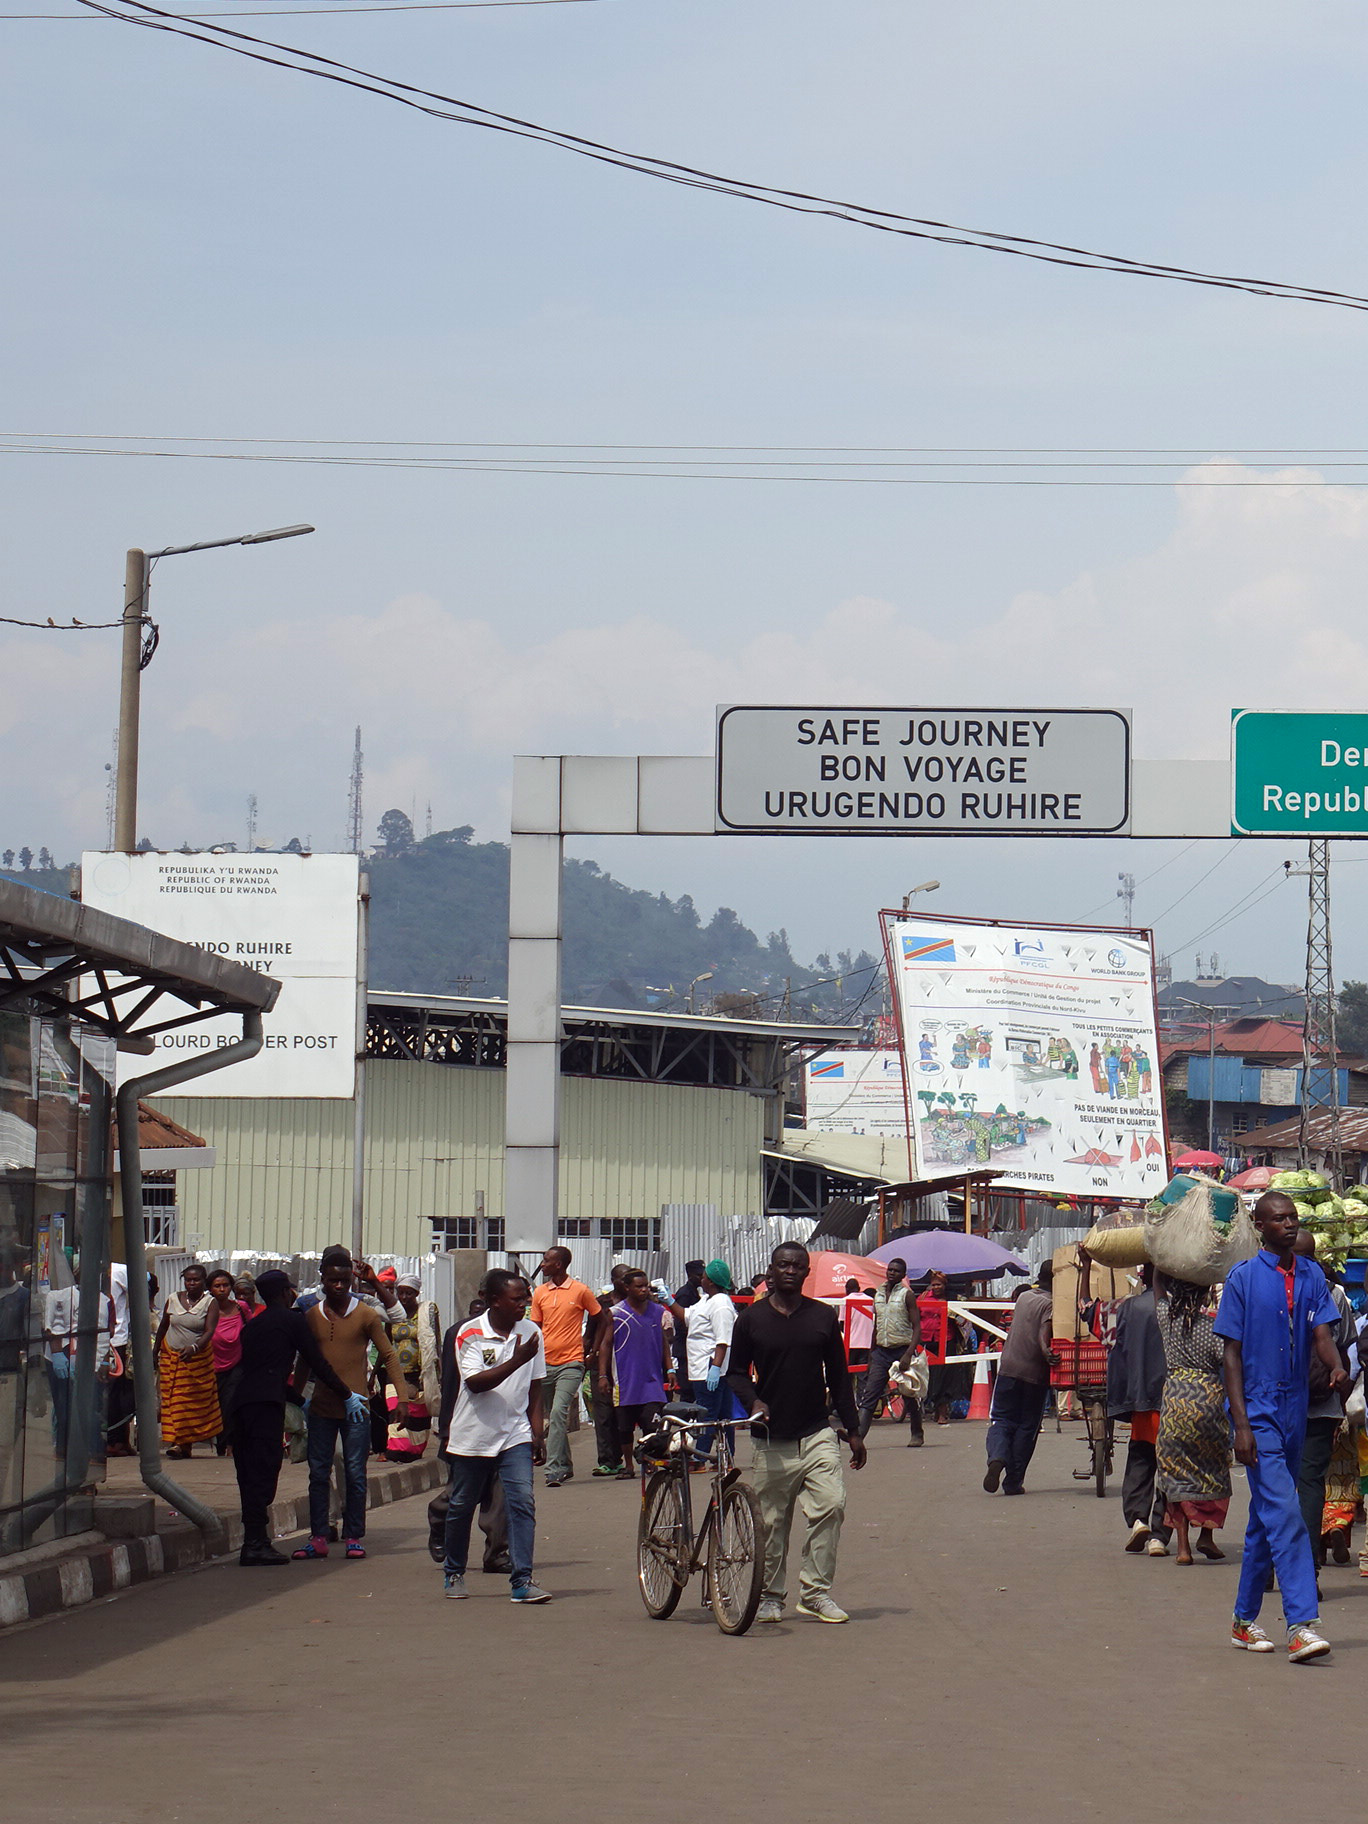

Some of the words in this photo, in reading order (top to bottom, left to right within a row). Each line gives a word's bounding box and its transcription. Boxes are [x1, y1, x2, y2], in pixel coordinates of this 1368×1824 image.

[797, 718, 881, 746] SAFE
[899, 719, 1051, 748] JOURNEY
[820, 754, 886, 782] BON
[903, 755, 1027, 784] VOYAGE
[764, 790, 946, 819] URUGENDO
[961, 792, 1082, 820] RUHIRE
[159, 866, 216, 875] REPUBULIKA
[219, 867, 235, 875] Y'U
[238, 867, 279, 875] RWANDA
[167, 876, 210, 884] REPUBLIC
[159, 885, 216, 894] REPUBLIQUE
[219, 886, 233, 894] DU
[236, 886, 278, 895] RWANDA
[236, 942, 293, 955] RUHIRE
[1090, 967, 1111, 975] WORLD
[1002, 989, 1030, 997] Commerce
[216, 1035, 288, 1049] BOER
[293, 1035, 338, 1049] POST
[1096, 1105, 1118, 1114] VIANDE
[1119, 1107, 1128, 1115] EN
[1079, 1115, 1115, 1124] SEULEMENT
[1126, 1118, 1156, 1127] QUARTIER
[1146, 1163, 1160, 1172] OUI
[1027, 1172, 1055, 1182] PIRATES
[1092, 1177, 1108, 1187] NON
